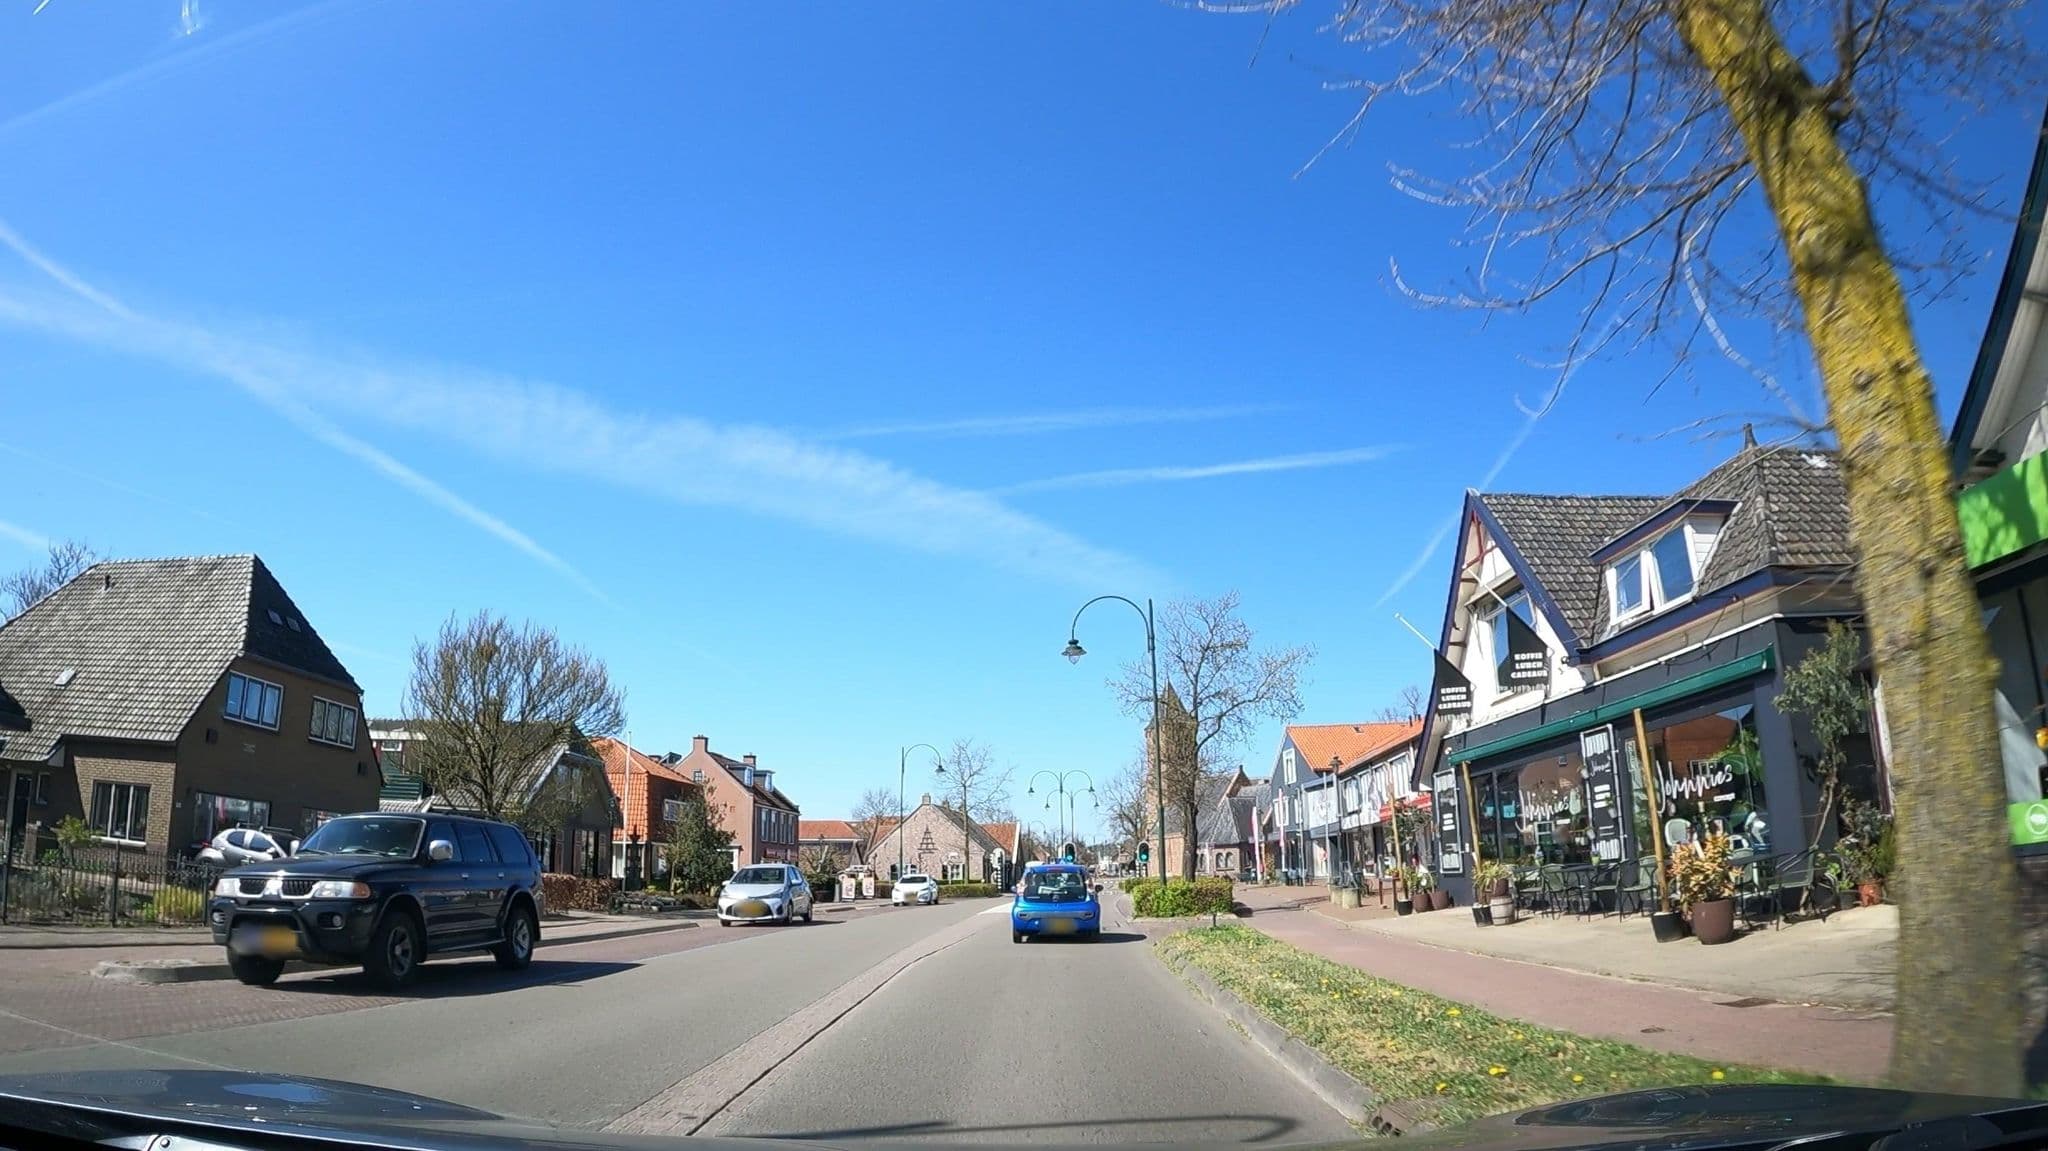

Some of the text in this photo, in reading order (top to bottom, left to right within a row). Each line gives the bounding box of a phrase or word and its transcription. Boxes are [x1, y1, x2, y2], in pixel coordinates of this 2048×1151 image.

[1514, 652, 1543, 661] KOFFIE
[1515, 661, 1543, 670] LUNCH
[1440, 686, 1467, 694] KOFFIE
[1441, 694, 1467, 702] LUNCH
